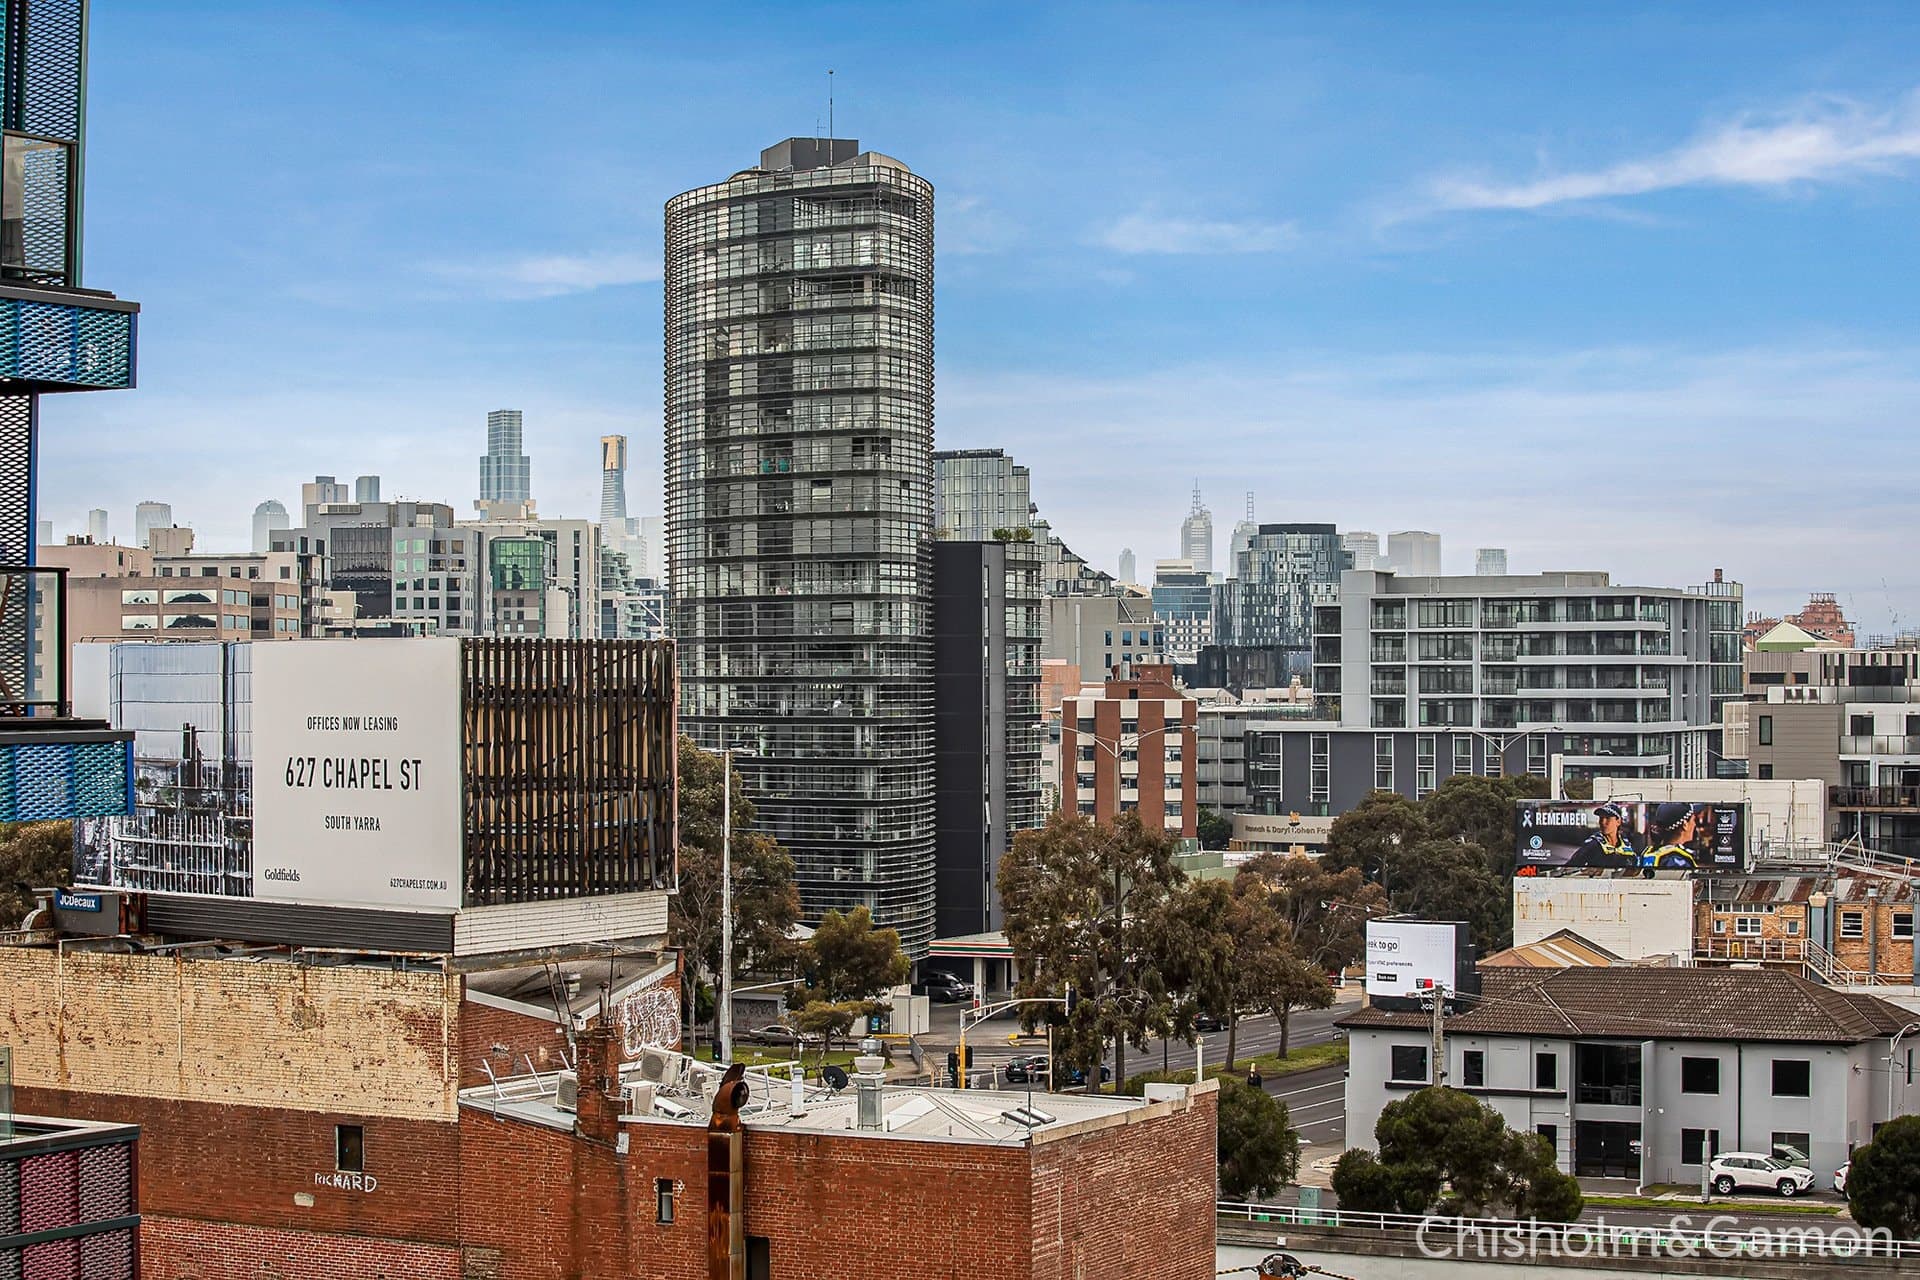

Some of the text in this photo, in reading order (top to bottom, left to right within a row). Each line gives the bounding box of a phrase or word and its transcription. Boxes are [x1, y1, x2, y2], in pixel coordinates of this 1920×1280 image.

[307, 716, 398, 731] OFFICES NOW LEASING
[285, 757, 422, 790] 627 CHAPEL ST
[325, 815, 381, 831] SOUTH YARRA
[1535, 812, 1587, 826] REMEMBER
[1272, 827, 1291, 835] Daryl
[264, 868, 300, 882] Goldfields
[389, 878, 447, 890] 627CHAPELST.COM.AU
[59, 894, 96, 908] JCDecaux
[1379, 941, 1387, 950] to
[1387, 942, 1398, 951] go
[315, 1172, 378, 1193] RICHARD
